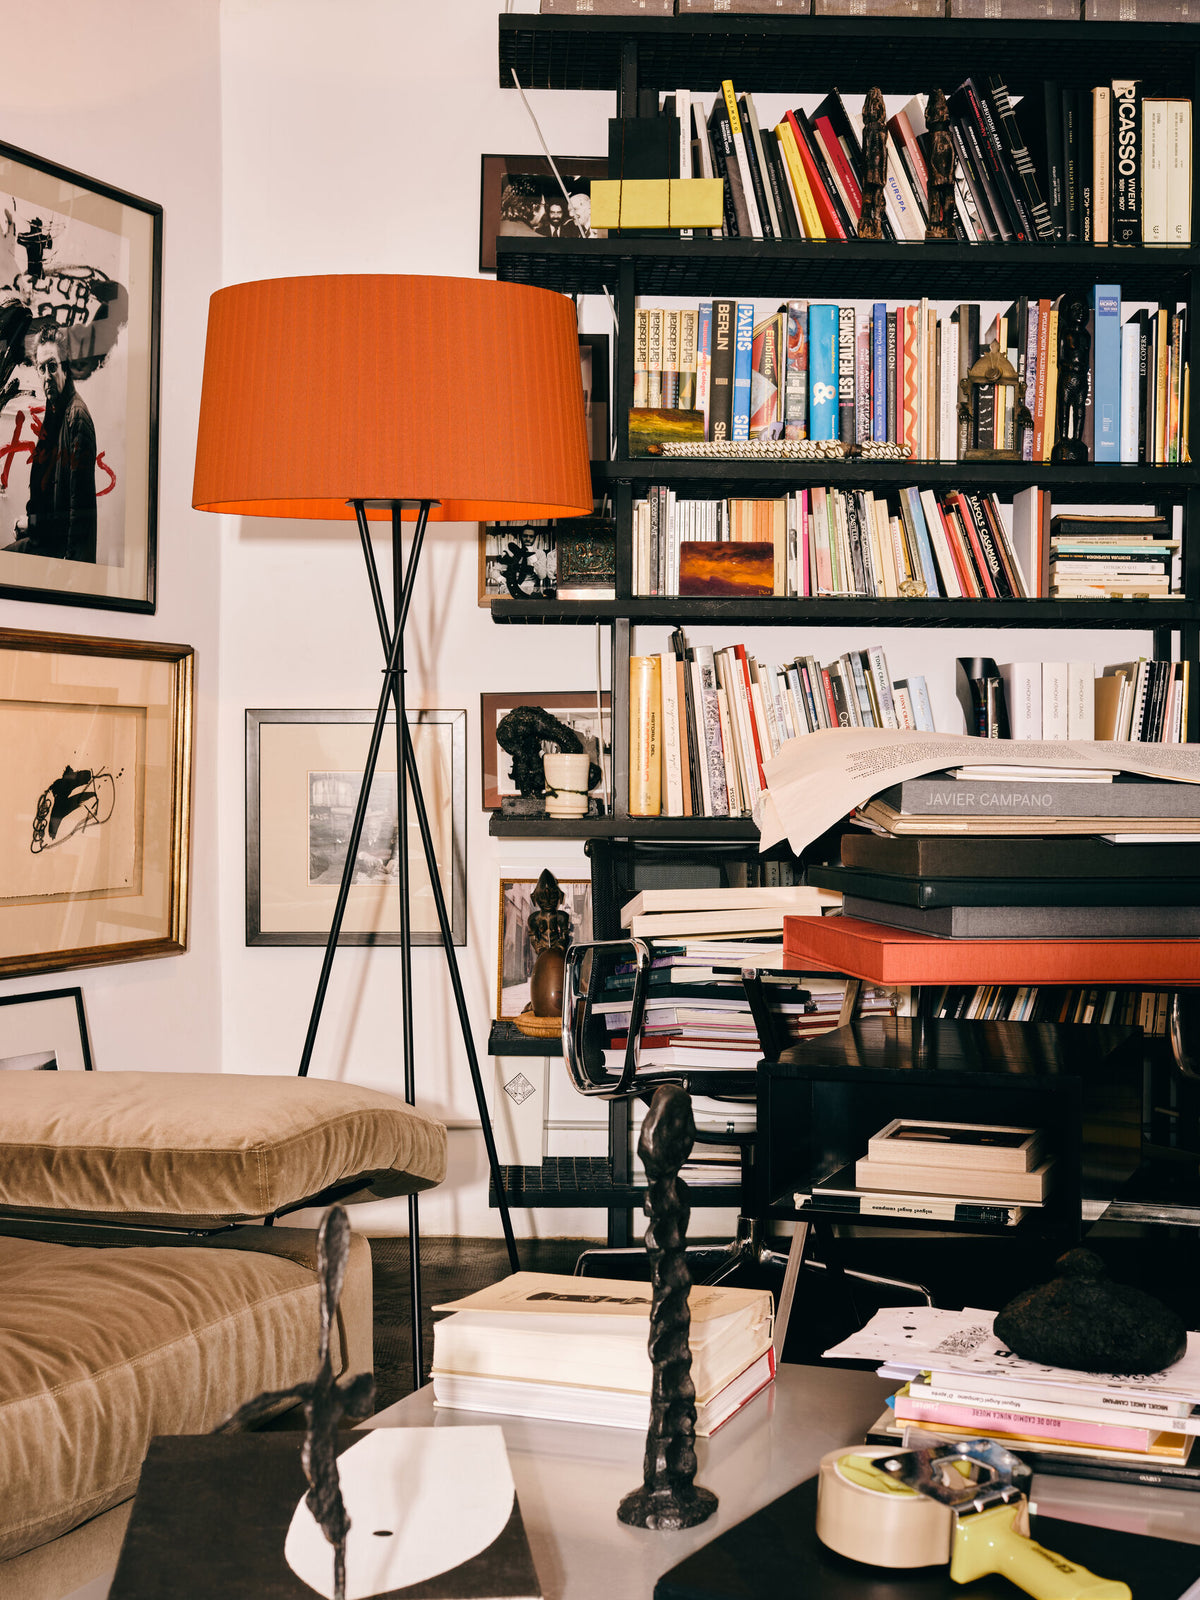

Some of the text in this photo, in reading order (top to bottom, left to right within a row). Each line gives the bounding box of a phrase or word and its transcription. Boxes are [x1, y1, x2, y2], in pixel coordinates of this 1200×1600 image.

[726, 89, 738, 132] SUGIMOTO
[981, 100, 996, 133] NOBUYOSHI
[993, 133, 1003, 151] ARAKI
[1118, 85, 1136, 176] PICASSO
[888, 177, 906, 212] EUROPA
[636, 312, 647, 346] abstrait
[650, 312, 660, 346] abstrait
[666, 312, 676, 346] abstrait
[683, 313, 693, 346] abstrait
[716, 304, 729, 350] BERLIN
[738, 304, 753, 351] PARIS
[764, 330, 775, 375] Einblicke
[839, 308, 854, 399] LES REALISMES
[847, 494, 858, 541] JORGE CASTILLO
[970, 495, 1000, 573] RÀFOLS CASAMADA
[882, 692, 890, 715] SECOND
[926, 793, 1052, 807] JAVIER CAMPANO
[957, 1394, 984, 1403] Campano
[971, 1409, 991, 1419] MUERE
[1001, 1399, 1021, 1408] Miguel
[1102, 1398, 1129, 1407] CAMPANO
[1148, 1402, 1168, 1411] MIGUEL
[992, 1411, 1012, 1422] NUNCA
[1014, 1414, 1036, 1424] CADMIO
[1046, 1418, 1061, 1427] ROJO
